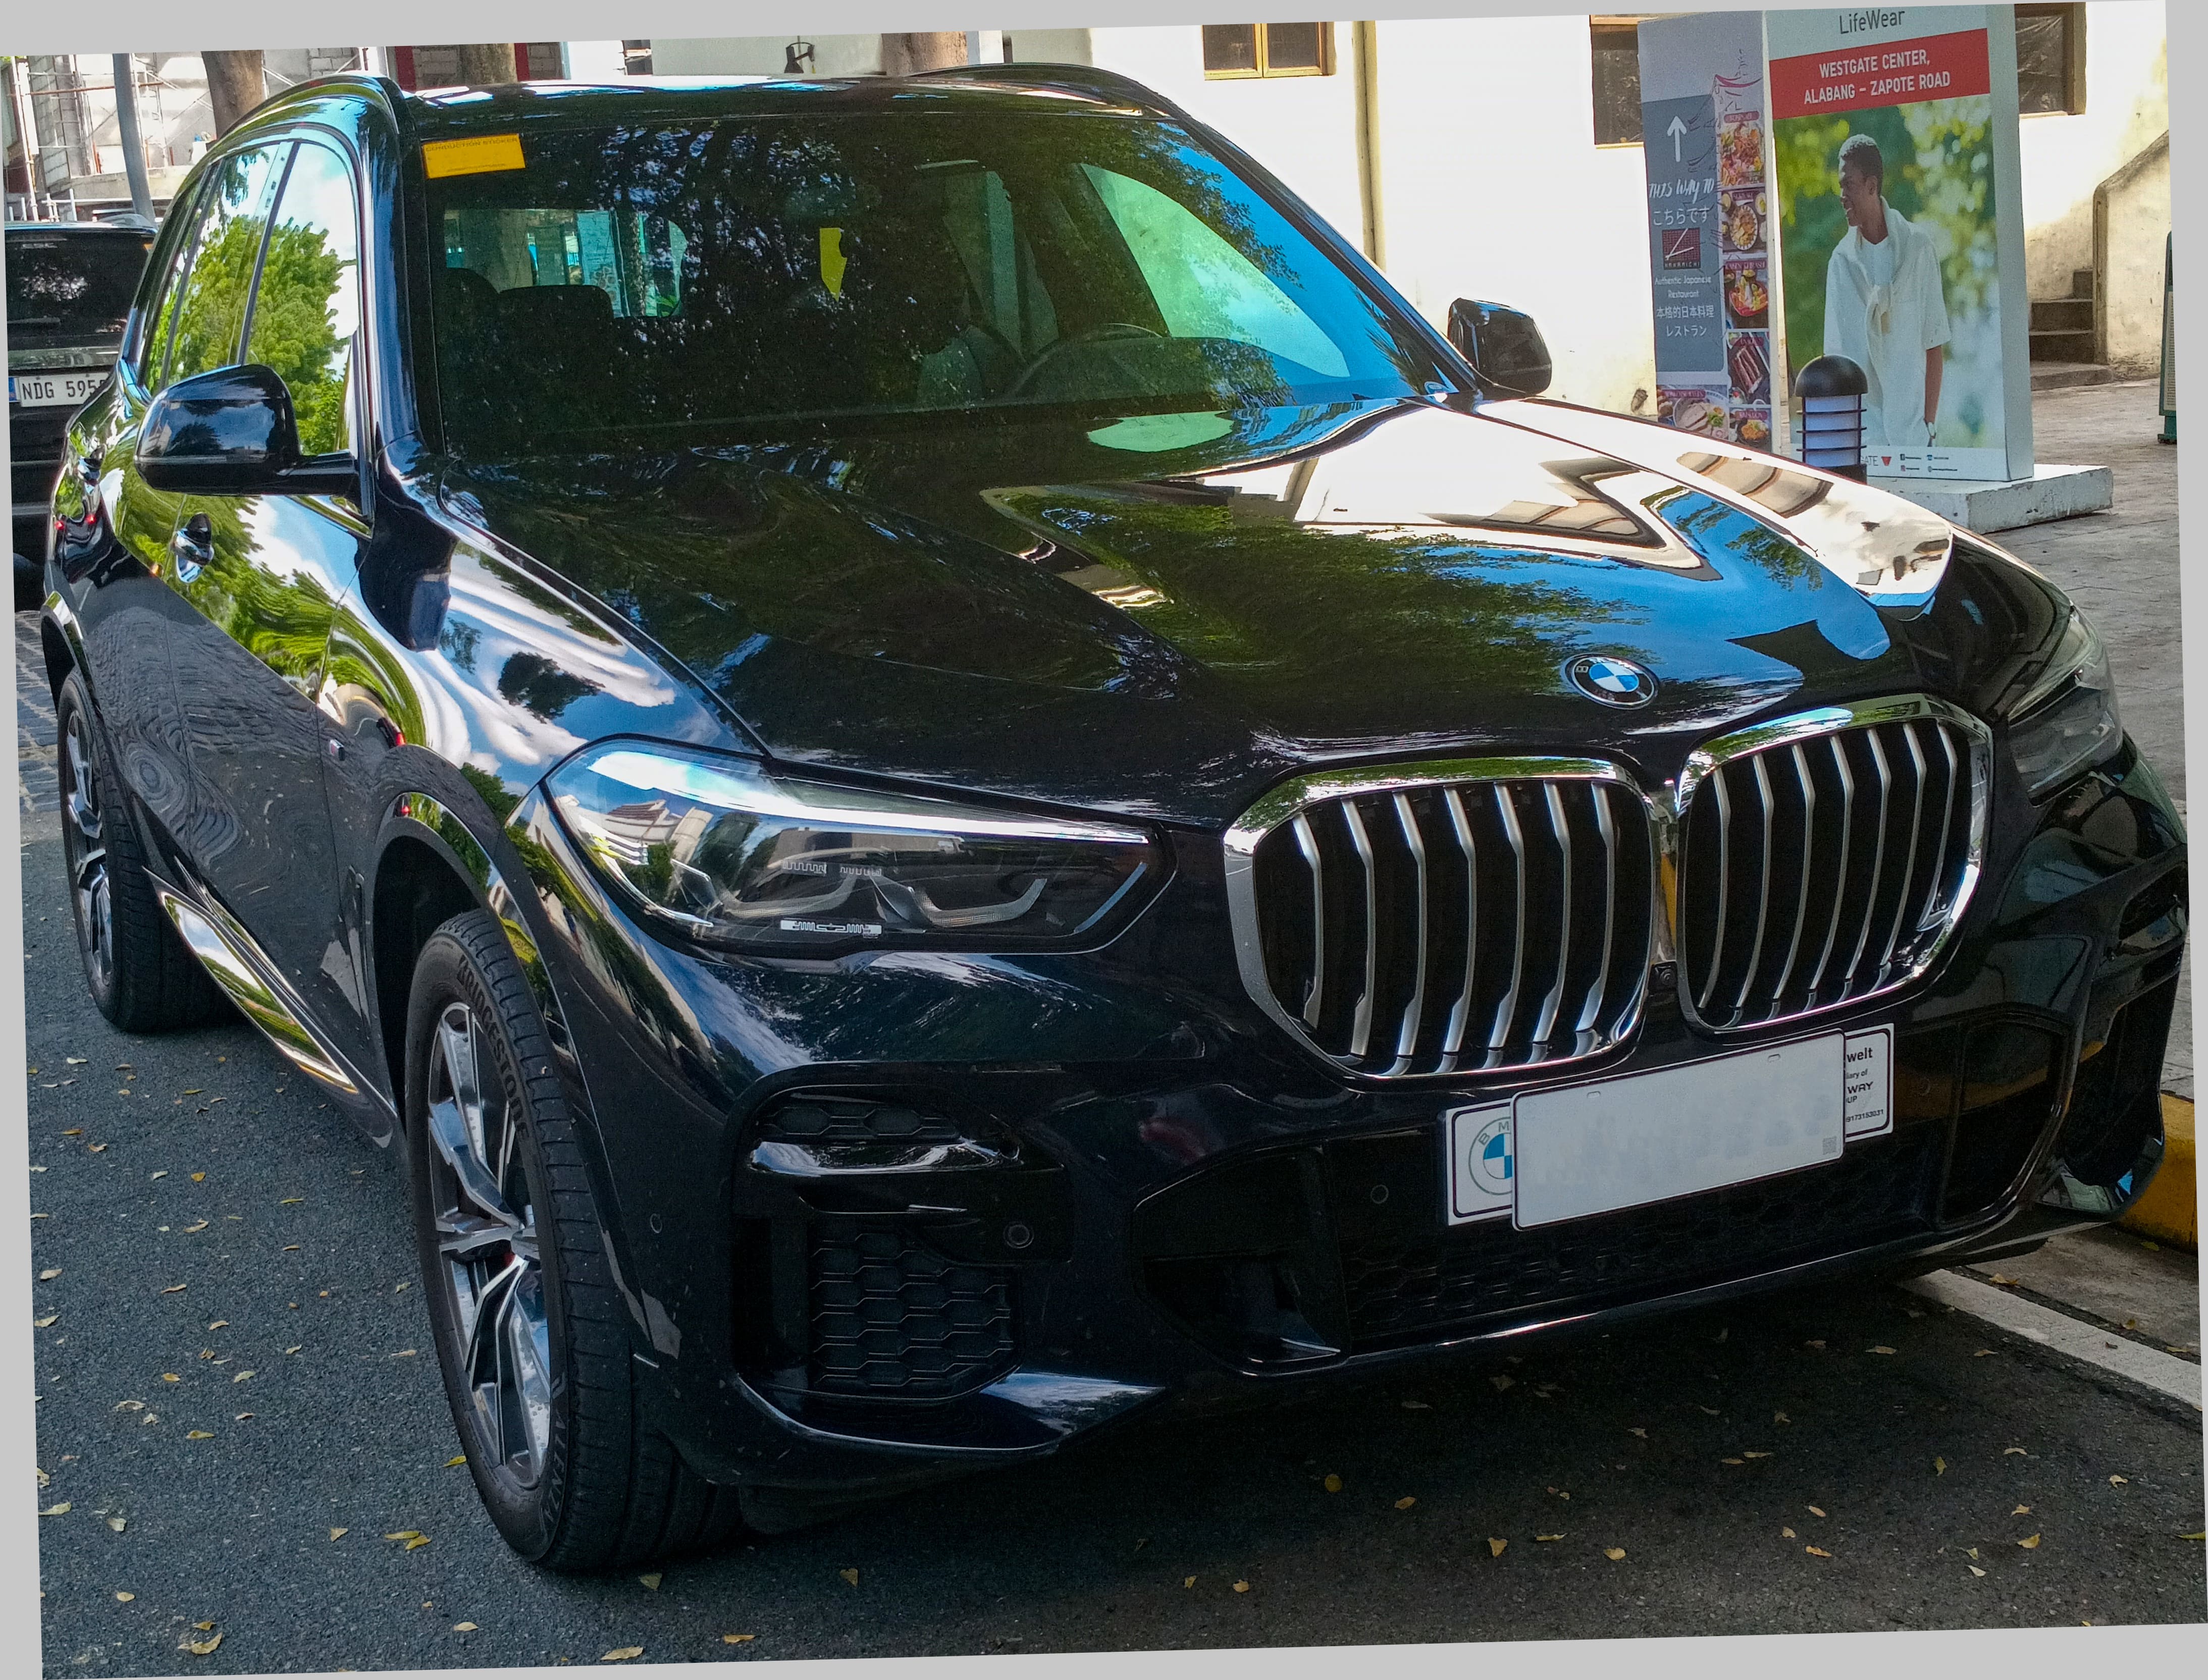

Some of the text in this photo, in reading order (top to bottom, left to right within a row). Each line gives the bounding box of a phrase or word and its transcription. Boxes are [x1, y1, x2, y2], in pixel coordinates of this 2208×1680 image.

[1839, 9, 1905, 34] LifeWear
[1819, 49, 1930, 79] WESTGATE CENTER,
[1804, 83, 1856, 104] ALABANG
[1870, 76, 1915, 96] ZAPOTE
[1919, 71, 1951, 90] ROAD
[1649, 182, 1672, 198] THIS
[1703, 178, 1715, 194] TO
[1653, 205, 1710, 225] こちらです
[1656, 305, 1714, 318] 本格的日本料理
[1666, 325, 1707, 337] レストラン
[22, 382, 55, 401] NDG
[1847, 1081, 1874, 1094] WAY
[1846, 1095, 1858, 1104] UP
